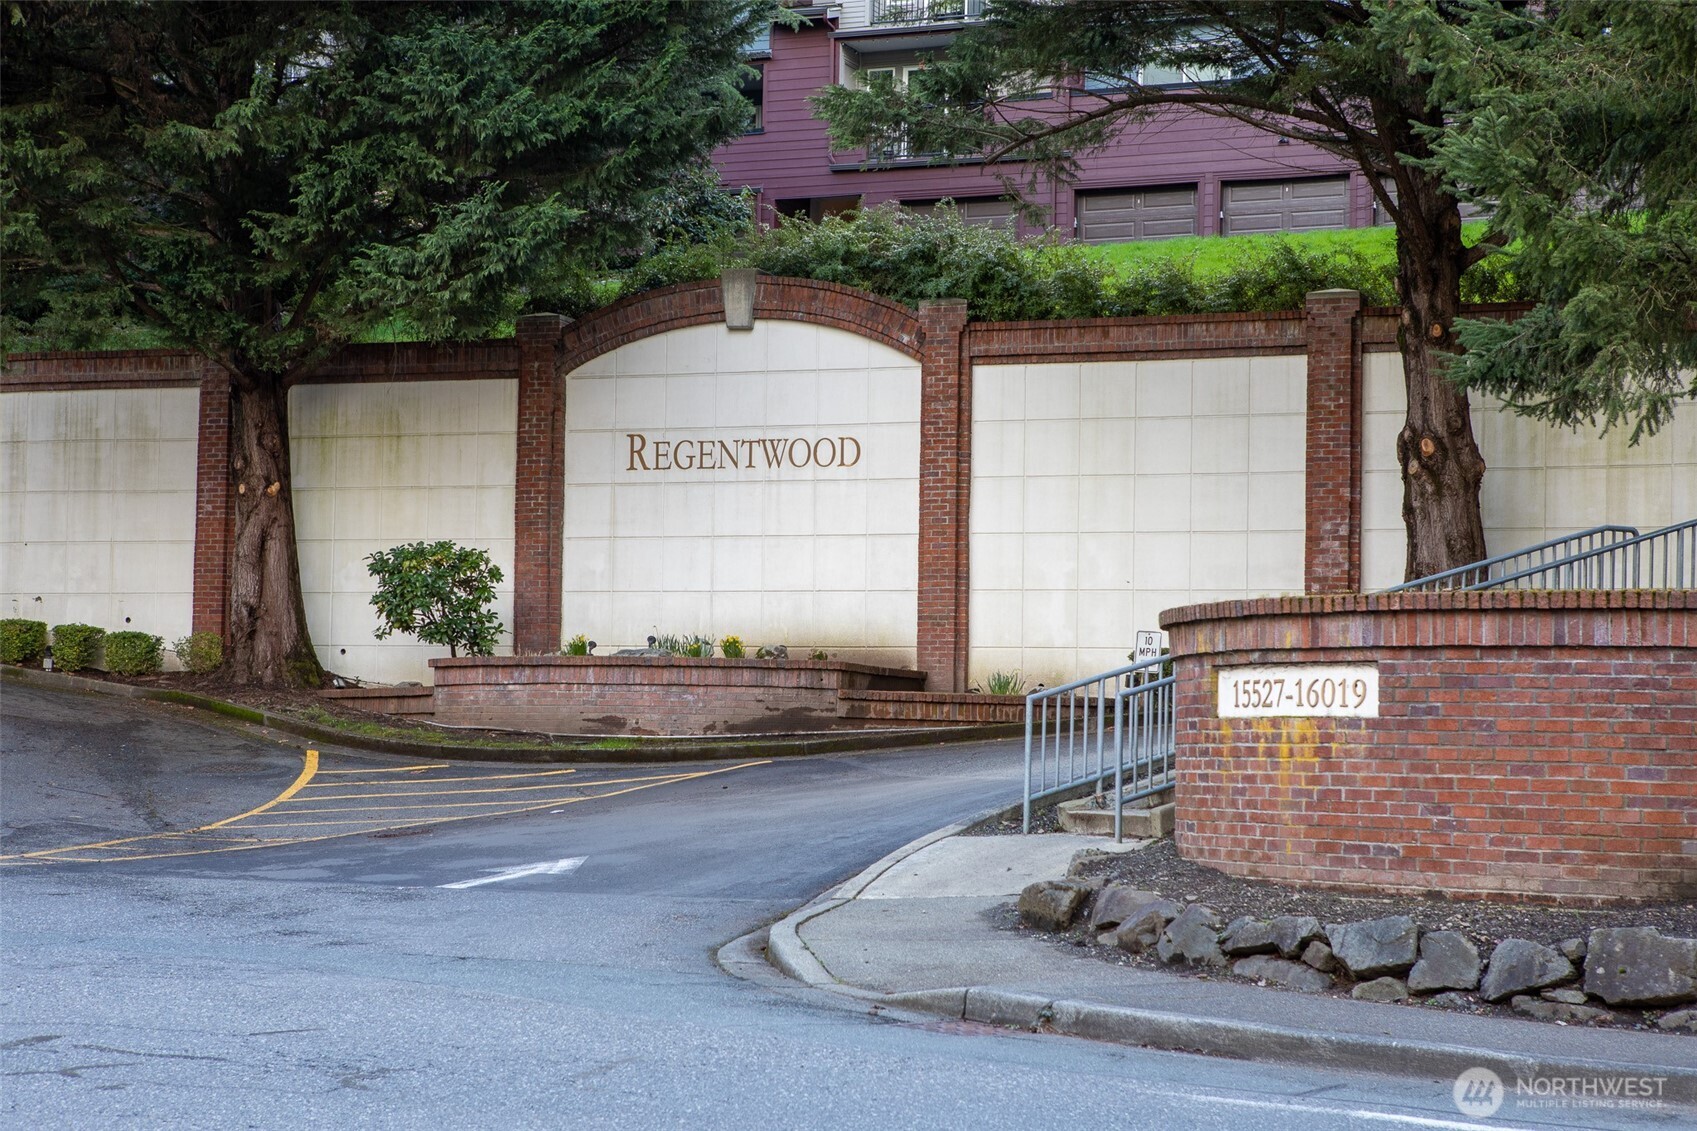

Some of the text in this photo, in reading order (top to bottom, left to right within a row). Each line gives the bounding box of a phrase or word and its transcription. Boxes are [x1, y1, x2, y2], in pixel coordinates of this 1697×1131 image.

[1145, 636, 1153, 646] 10
[1139, 648, 1157, 656] MPH
[1233, 678, 1367, 708] 15527-16019
